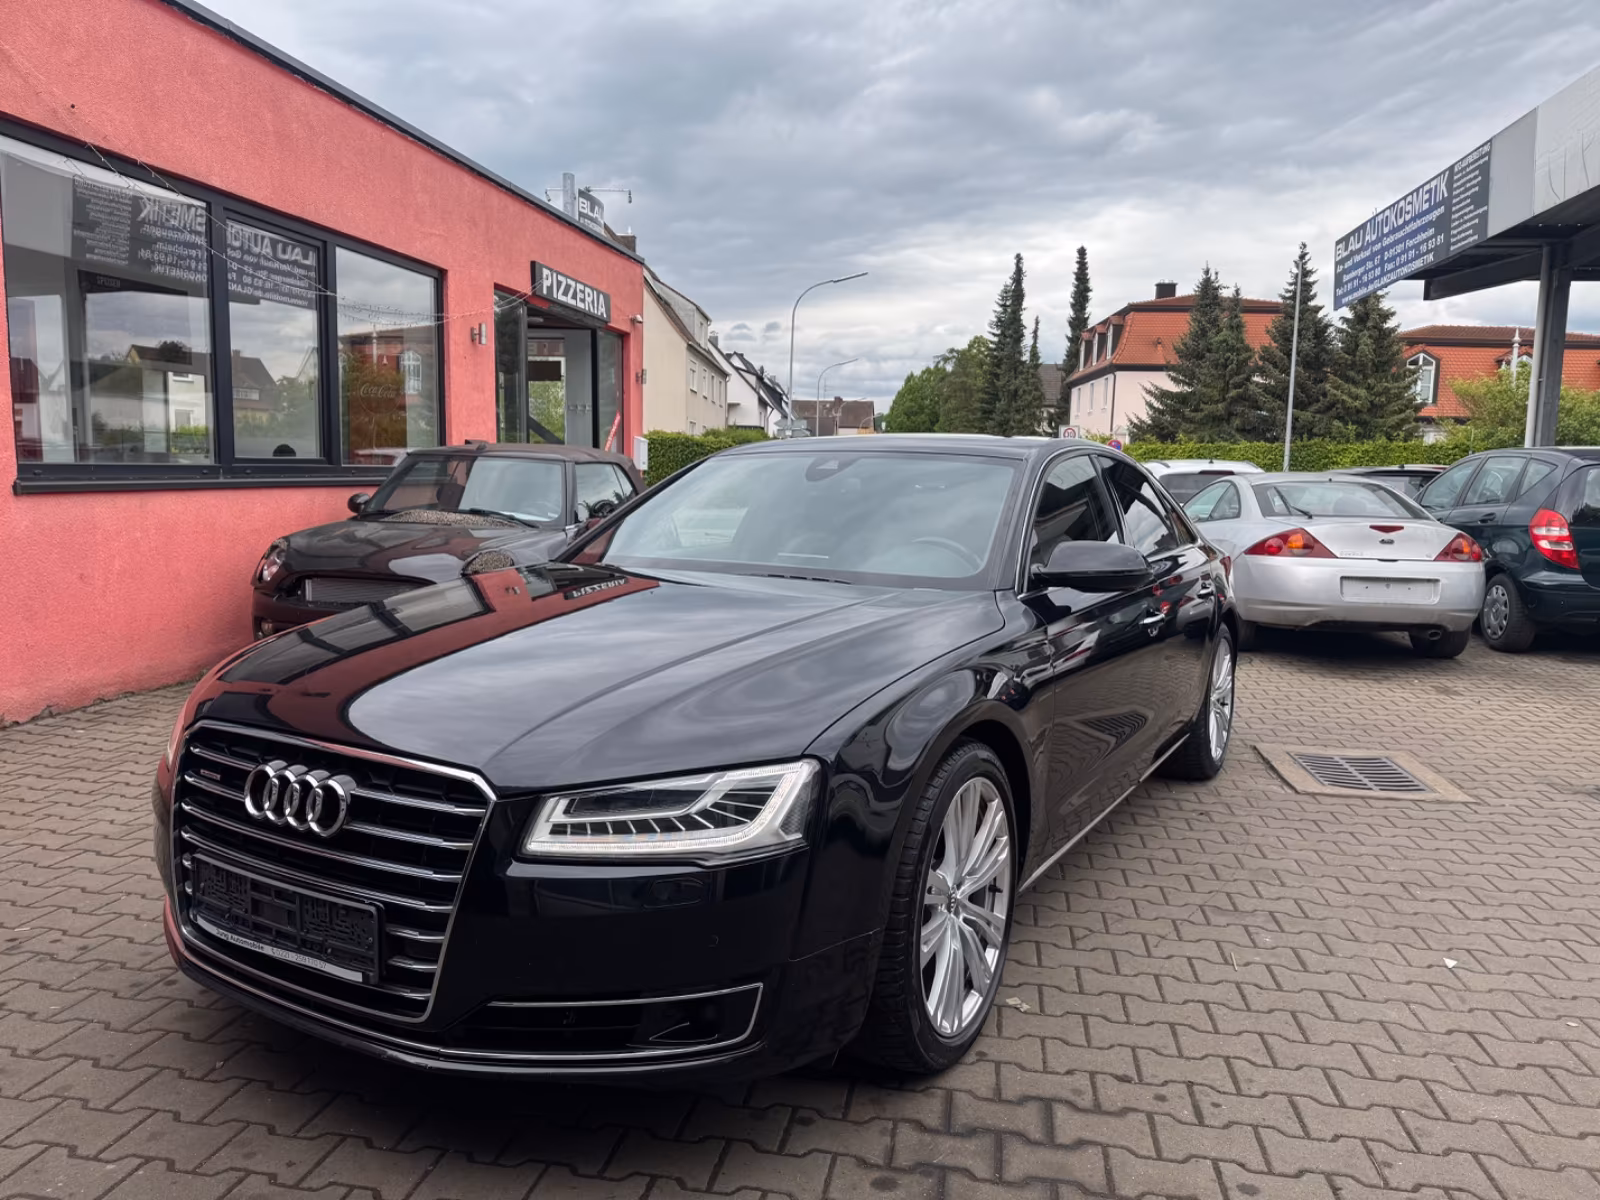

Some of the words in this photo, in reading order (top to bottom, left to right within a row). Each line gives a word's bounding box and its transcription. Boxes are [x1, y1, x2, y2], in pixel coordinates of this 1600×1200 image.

[1336, 229, 1363, 262] BLAU
[1364, 170, 1449, 246] AUTOKOSMETIK
[1405, 227, 1435, 249] Forchheim
[1344, 258, 1353, 269] und
[1353, 246, 1371, 263] Verkauf
[1372, 242, 1382, 252] von
[542, 267, 607, 318] PIZZERIA
[230, 935, 265, 952] Automobile
